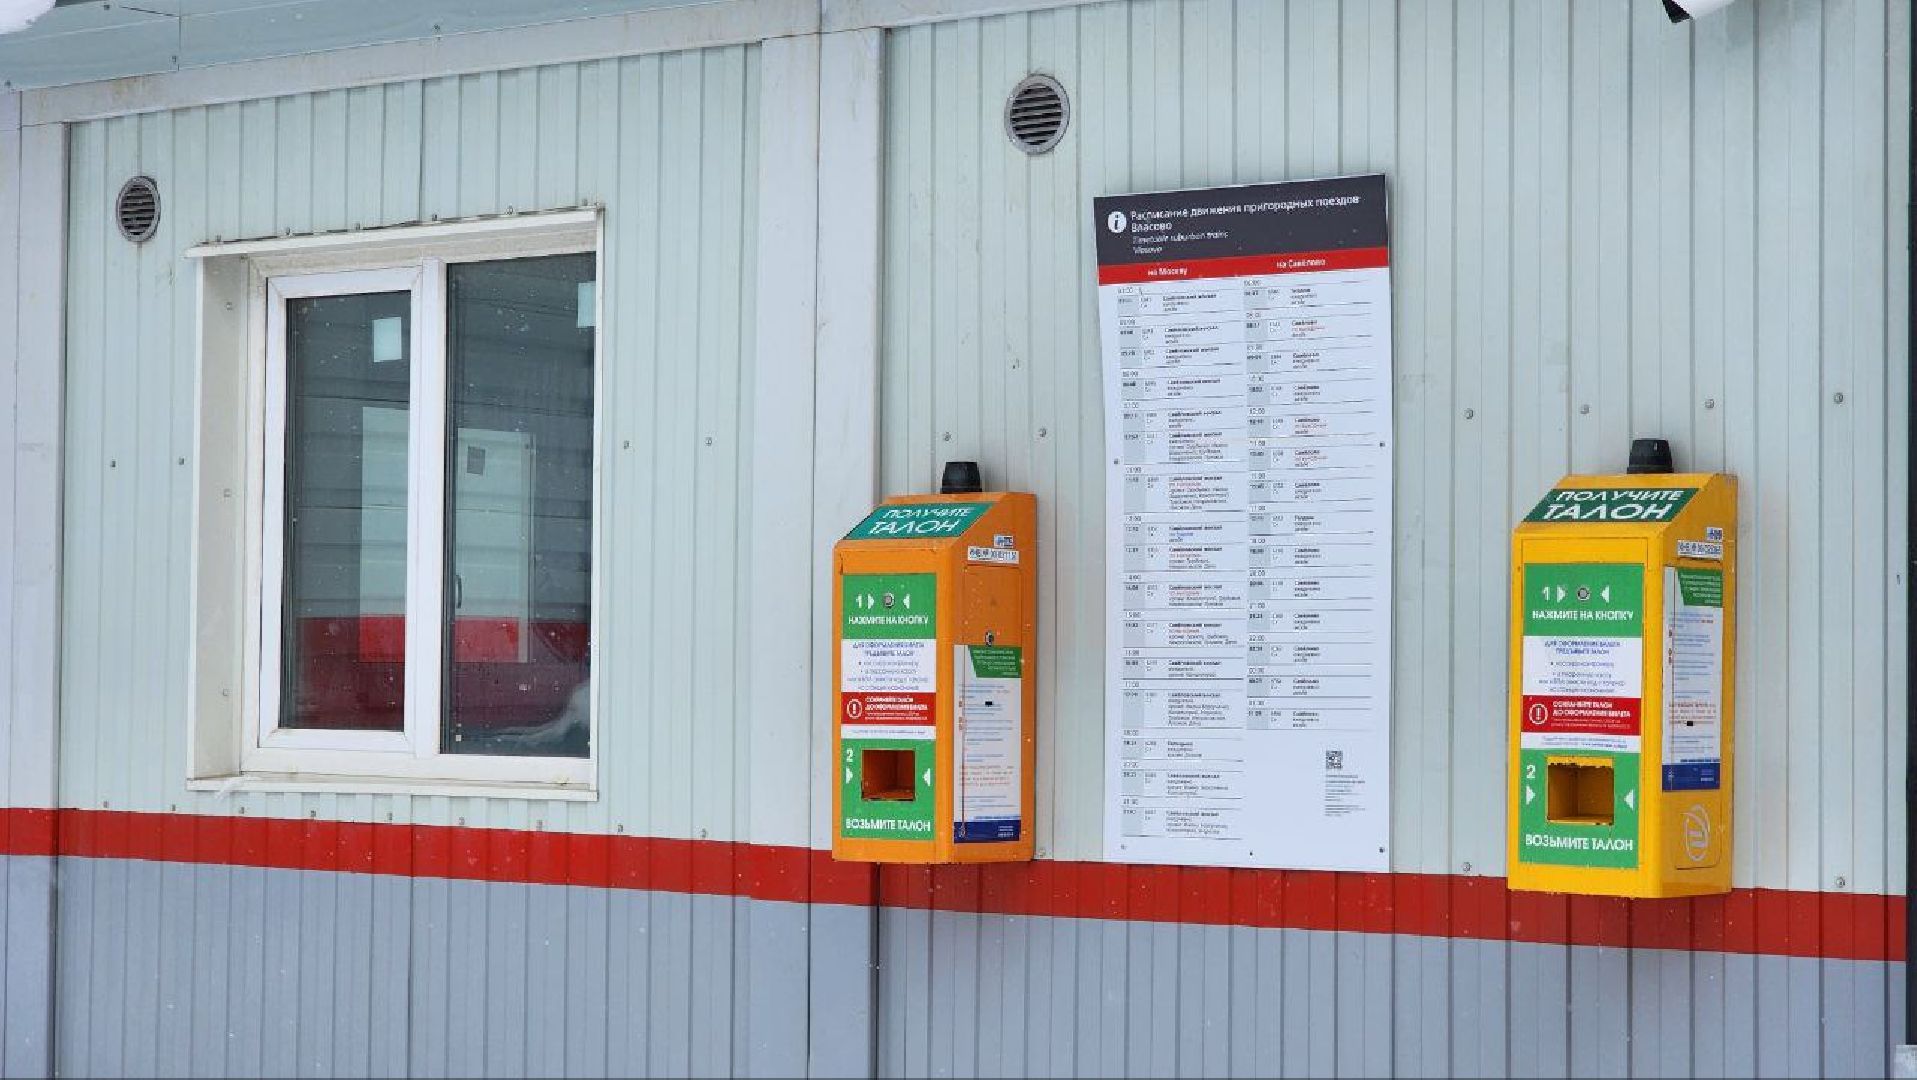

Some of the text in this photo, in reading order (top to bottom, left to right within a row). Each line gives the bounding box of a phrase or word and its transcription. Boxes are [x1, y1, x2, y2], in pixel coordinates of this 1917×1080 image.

[1131, 195, 1360, 221] Расписание движения пригородных поездов
[1555, 490, 1684, 501] ПОЛУЧИТЕ
[882, 507, 971, 519] ПОЛУЧИТЕ
[1543, 503, 1673, 520] ТАЛОН
[868, 519, 959, 534] ТАЛОН
[855, 593, 863, 609] 1
[1542, 586, 1550, 601] 1
[848, 615, 929, 625] НАЖМИТЕ НА КНОПКУ
[1532, 610, 1634, 621] НАЖМИТЕ НА КНОПКУ
[846, 749, 853, 763] 2
[1526, 764, 1536, 779] 2
[845, 818, 931, 832] ВОЗЬМИТЕ ТАЛОН
[1525, 834, 1634, 851] ВОЗЬМИТЕ ТАЛОН
